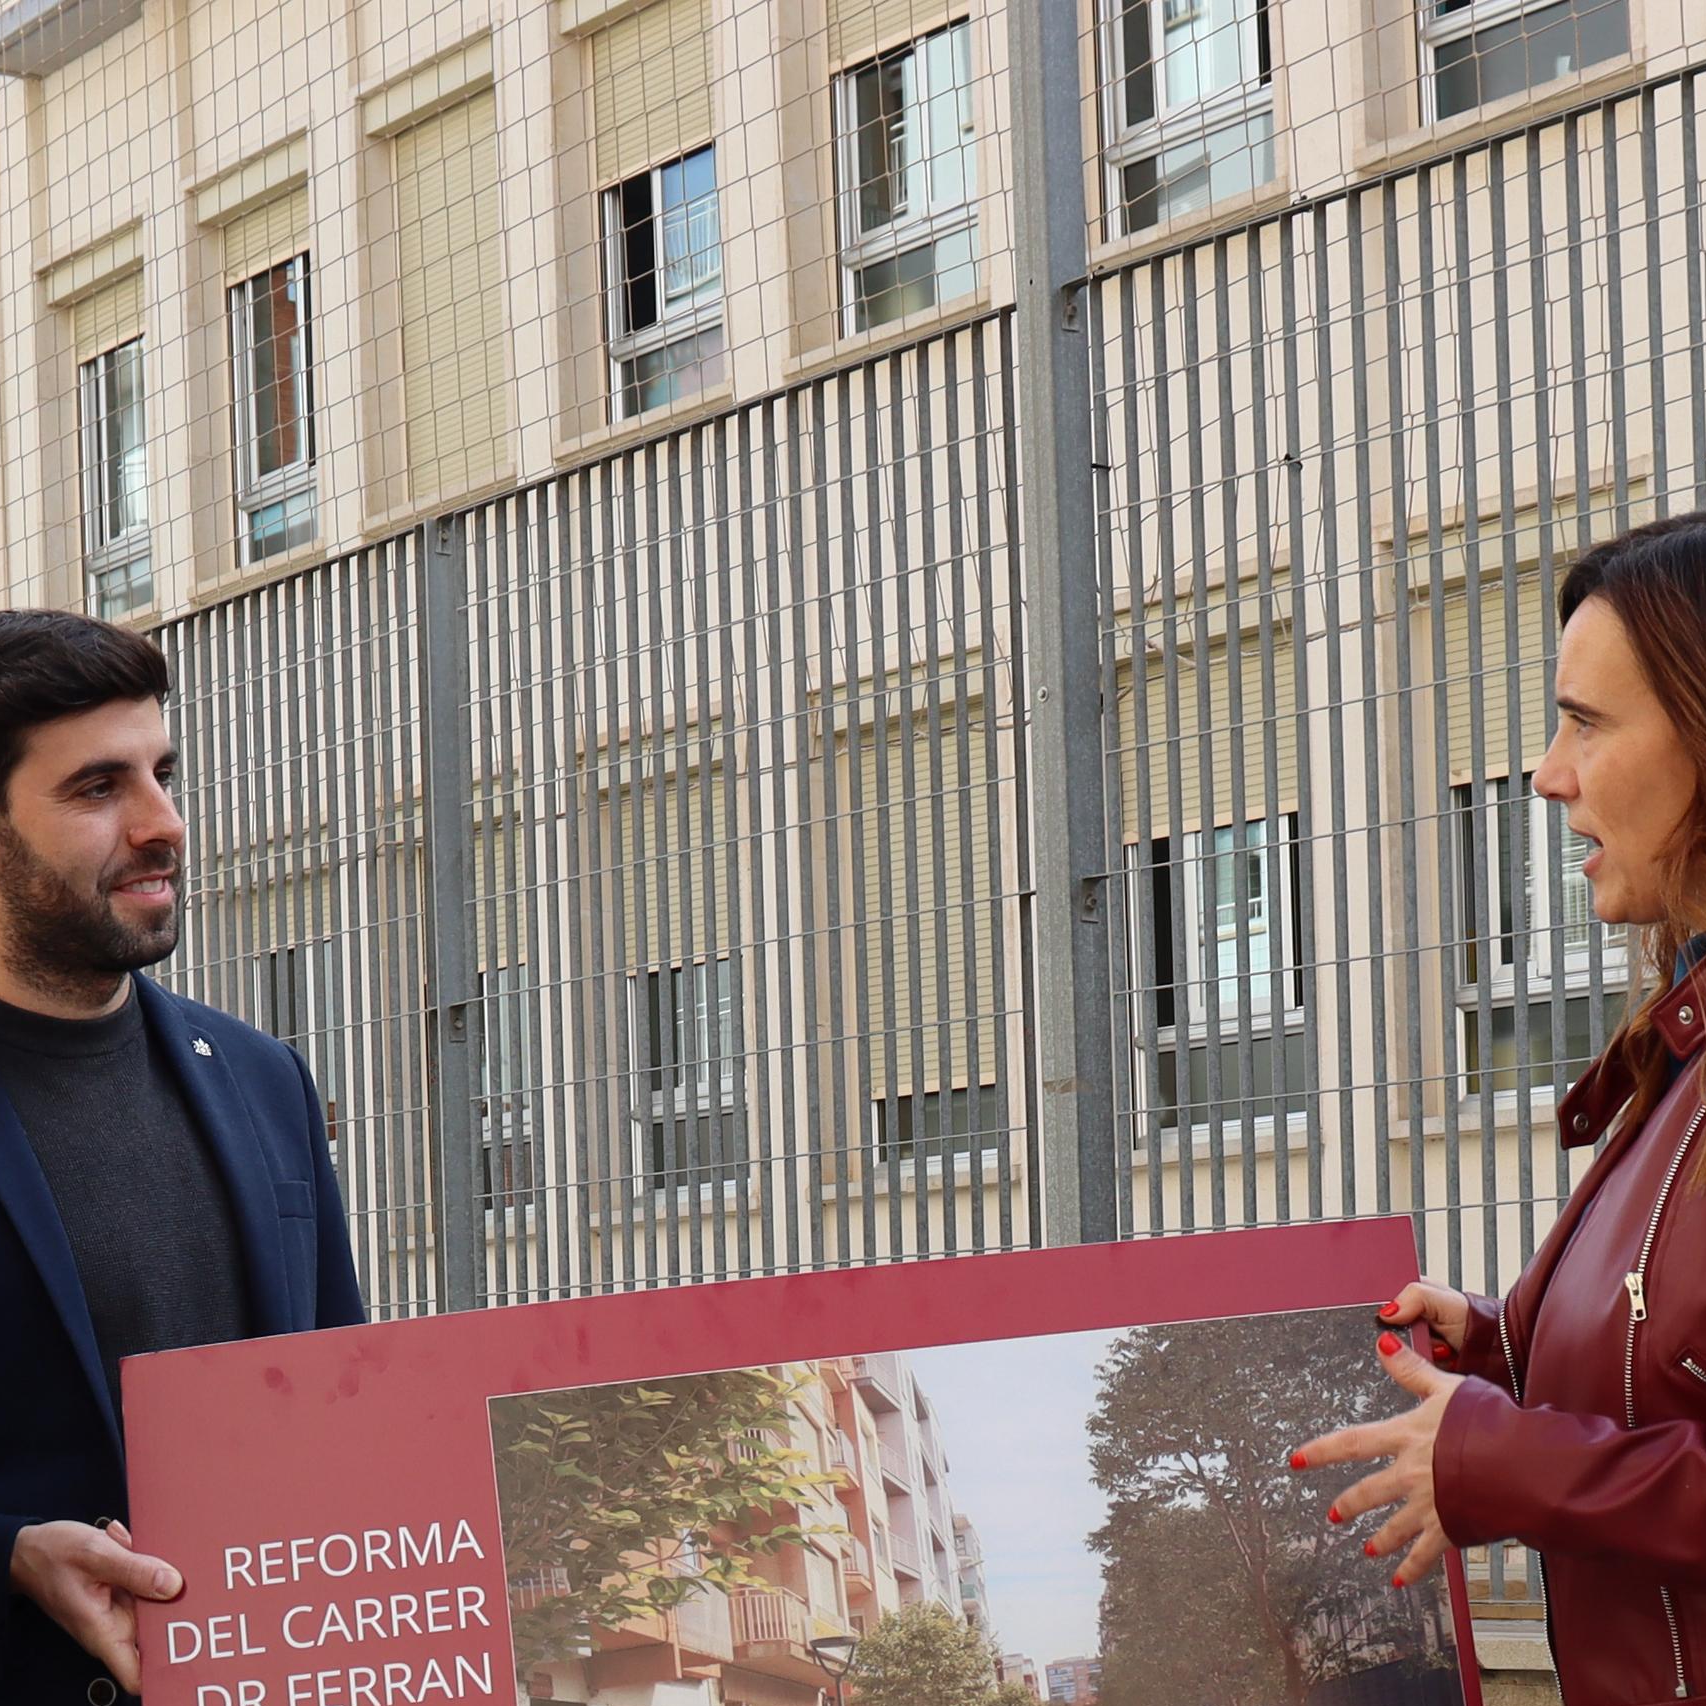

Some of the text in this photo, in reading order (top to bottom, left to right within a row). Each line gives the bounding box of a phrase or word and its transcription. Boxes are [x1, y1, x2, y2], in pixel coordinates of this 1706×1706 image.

[224, 1518, 485, 1591] REFORMA
[167, 1585, 491, 1665] DEL CARRER
